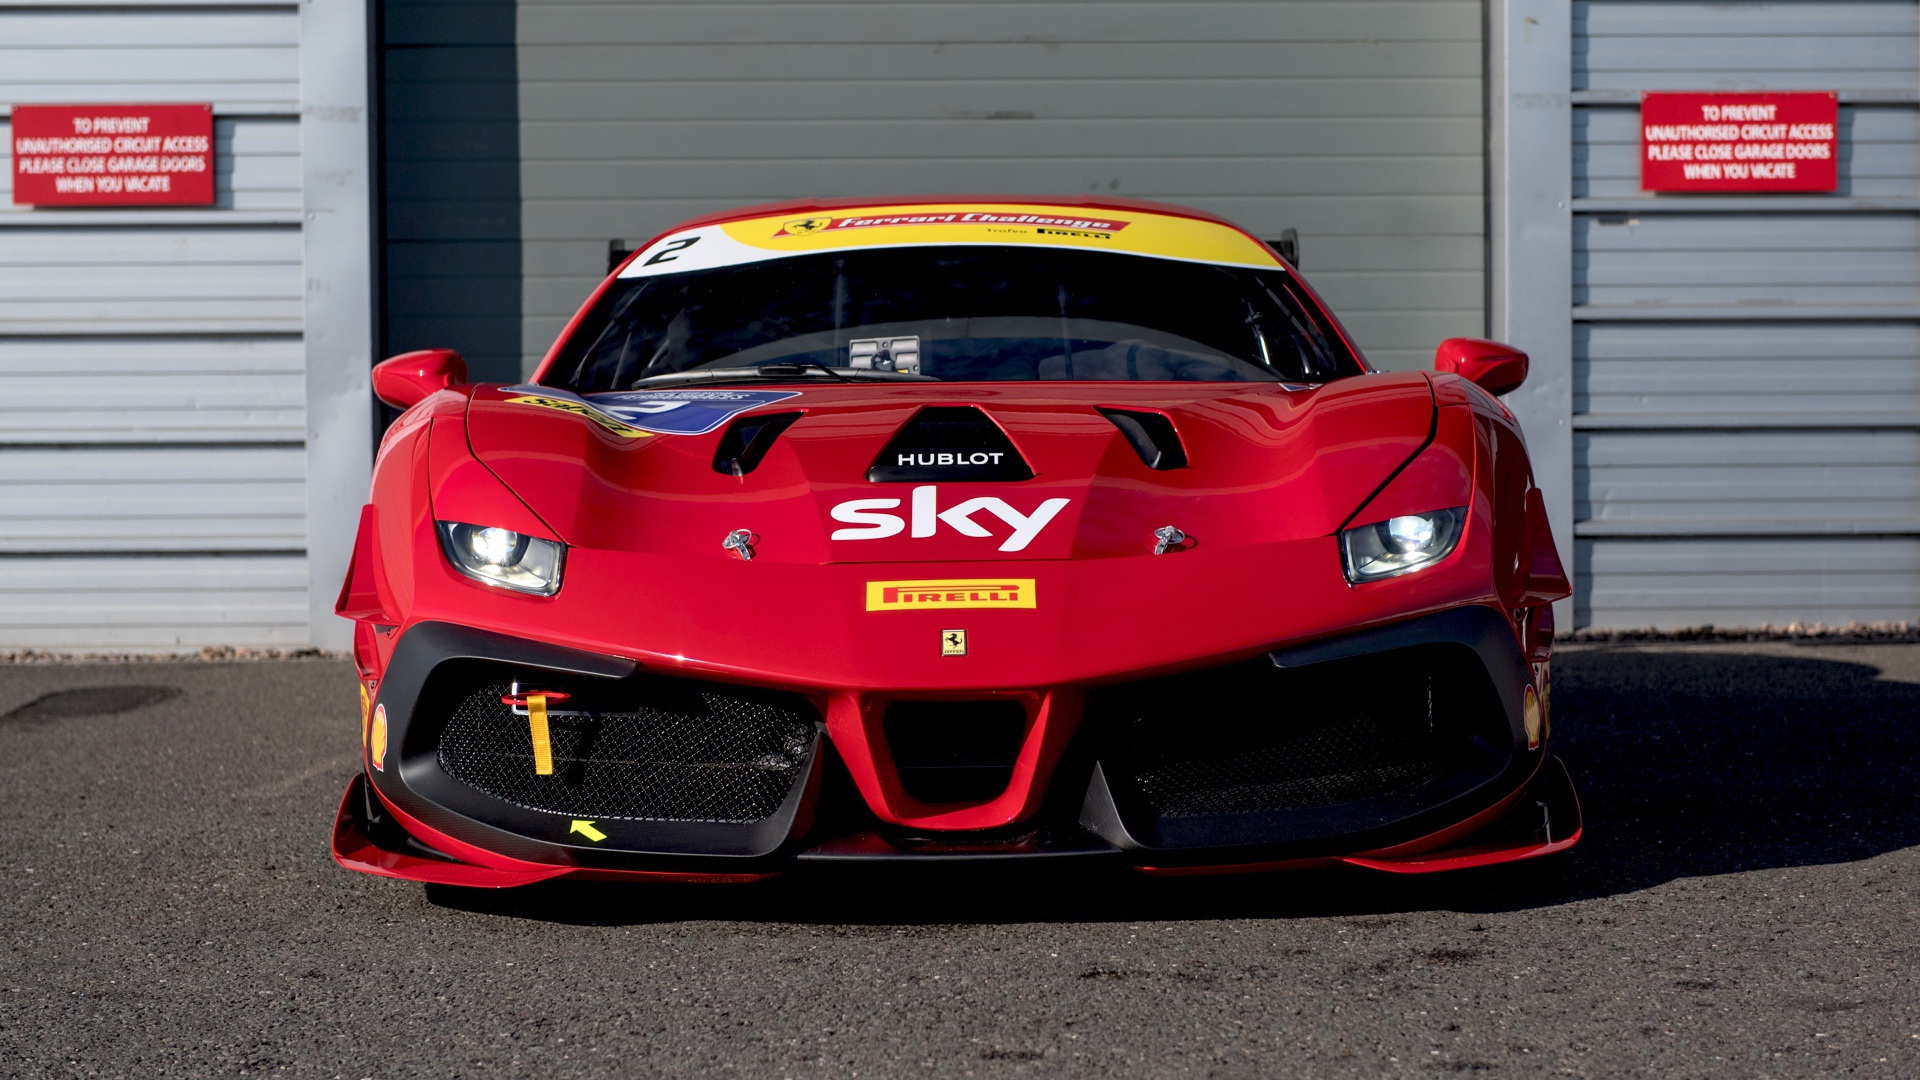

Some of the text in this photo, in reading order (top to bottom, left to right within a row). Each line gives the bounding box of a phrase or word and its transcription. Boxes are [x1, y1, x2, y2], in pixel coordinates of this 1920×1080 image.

[1702, 104, 1777, 121] TO PREVENT
[73, 117, 150, 134] TO PREVENT
[1645, 124, 1834, 141] UNAUTHORISED CIRCUIT ACCESS
[16, 136, 209, 154] UNAUTHORISED CIRCUIT ACCESS
[1648, 143, 1830, 160] PLEASE CLOSE GARAGE DOORS
[19, 155, 206, 174] PLEASE CLOSE GARAGE DOORS
[1683, 162, 1796, 180] WHEN YOU VACATE
[55, 176, 171, 193] WHEN YOU VACATE
[838, 213, 1112, 229] Ferrari Challenge
[1037, 228, 1111, 239] PIRELLI
[641, 236, 701, 267] 2
[897, 452, 1004, 467] HUBLOT
[830, 485, 1071, 552] sky
[883, 584, 1020, 604] PIRELLI
